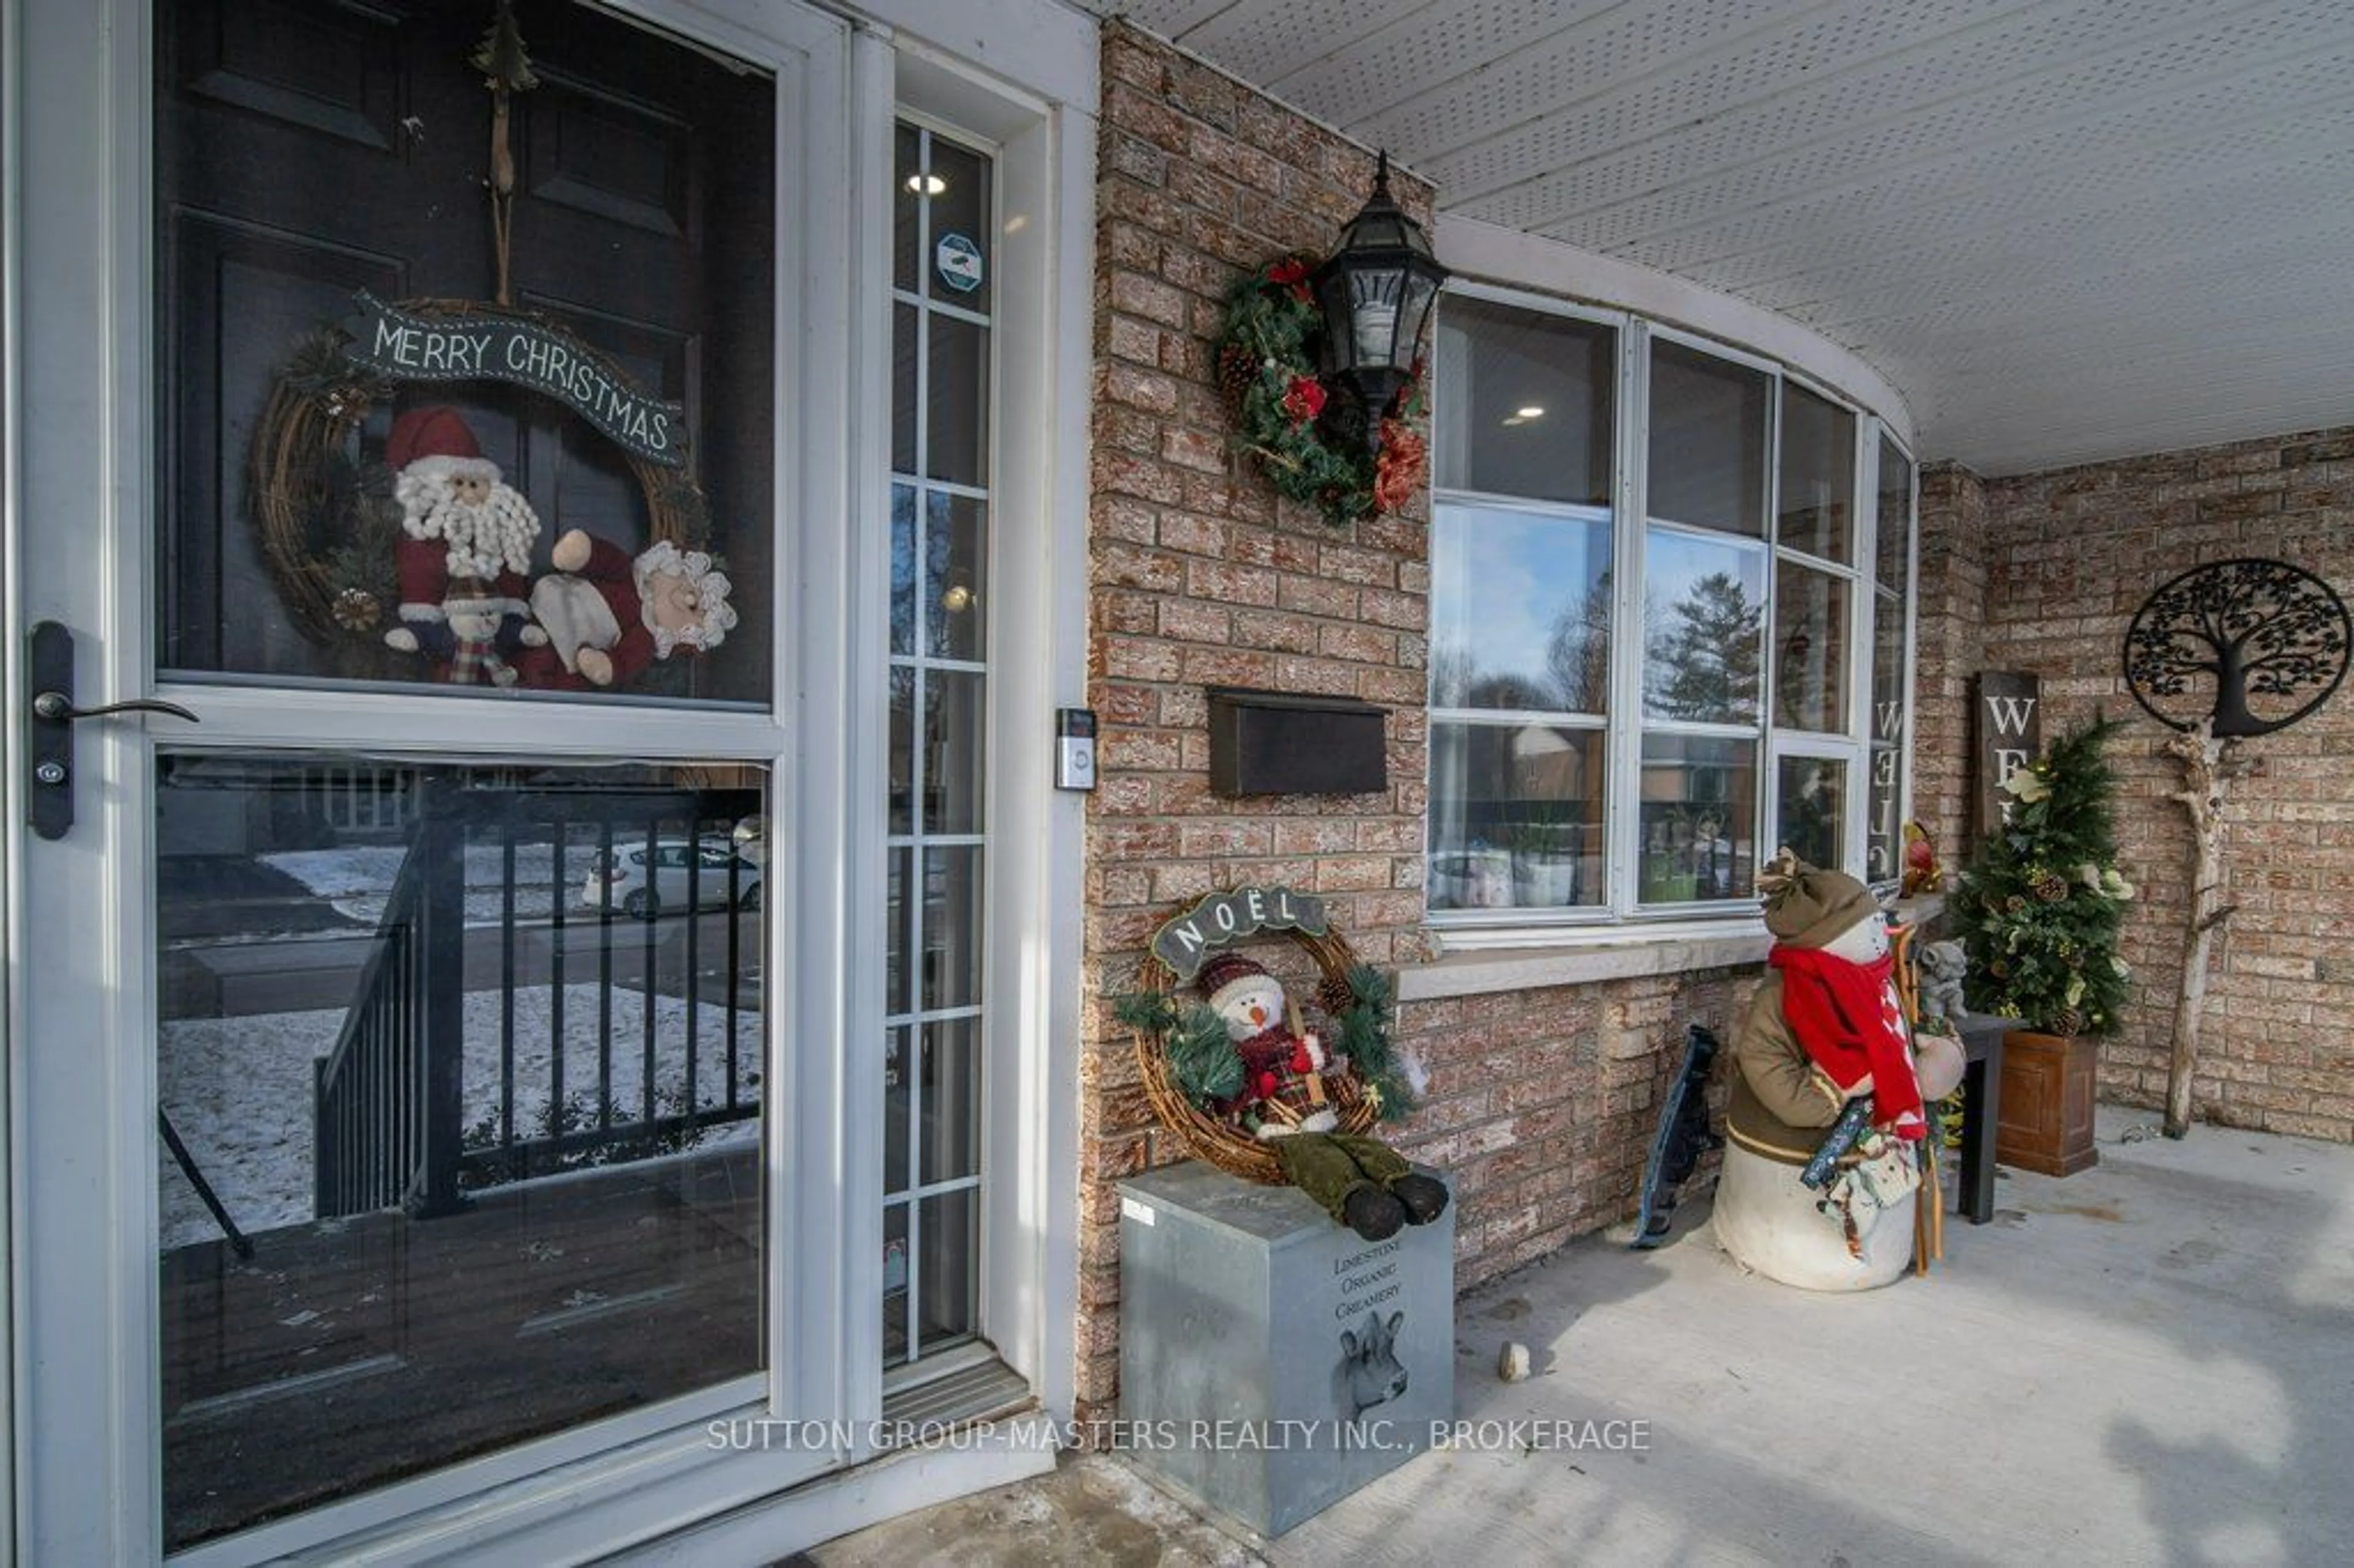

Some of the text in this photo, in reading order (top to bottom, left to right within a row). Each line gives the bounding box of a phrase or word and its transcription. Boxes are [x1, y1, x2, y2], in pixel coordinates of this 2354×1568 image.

[373, 318, 669, 451] MERRY CHRISTMAS
[1175, 889, 1295, 953] NOËL
